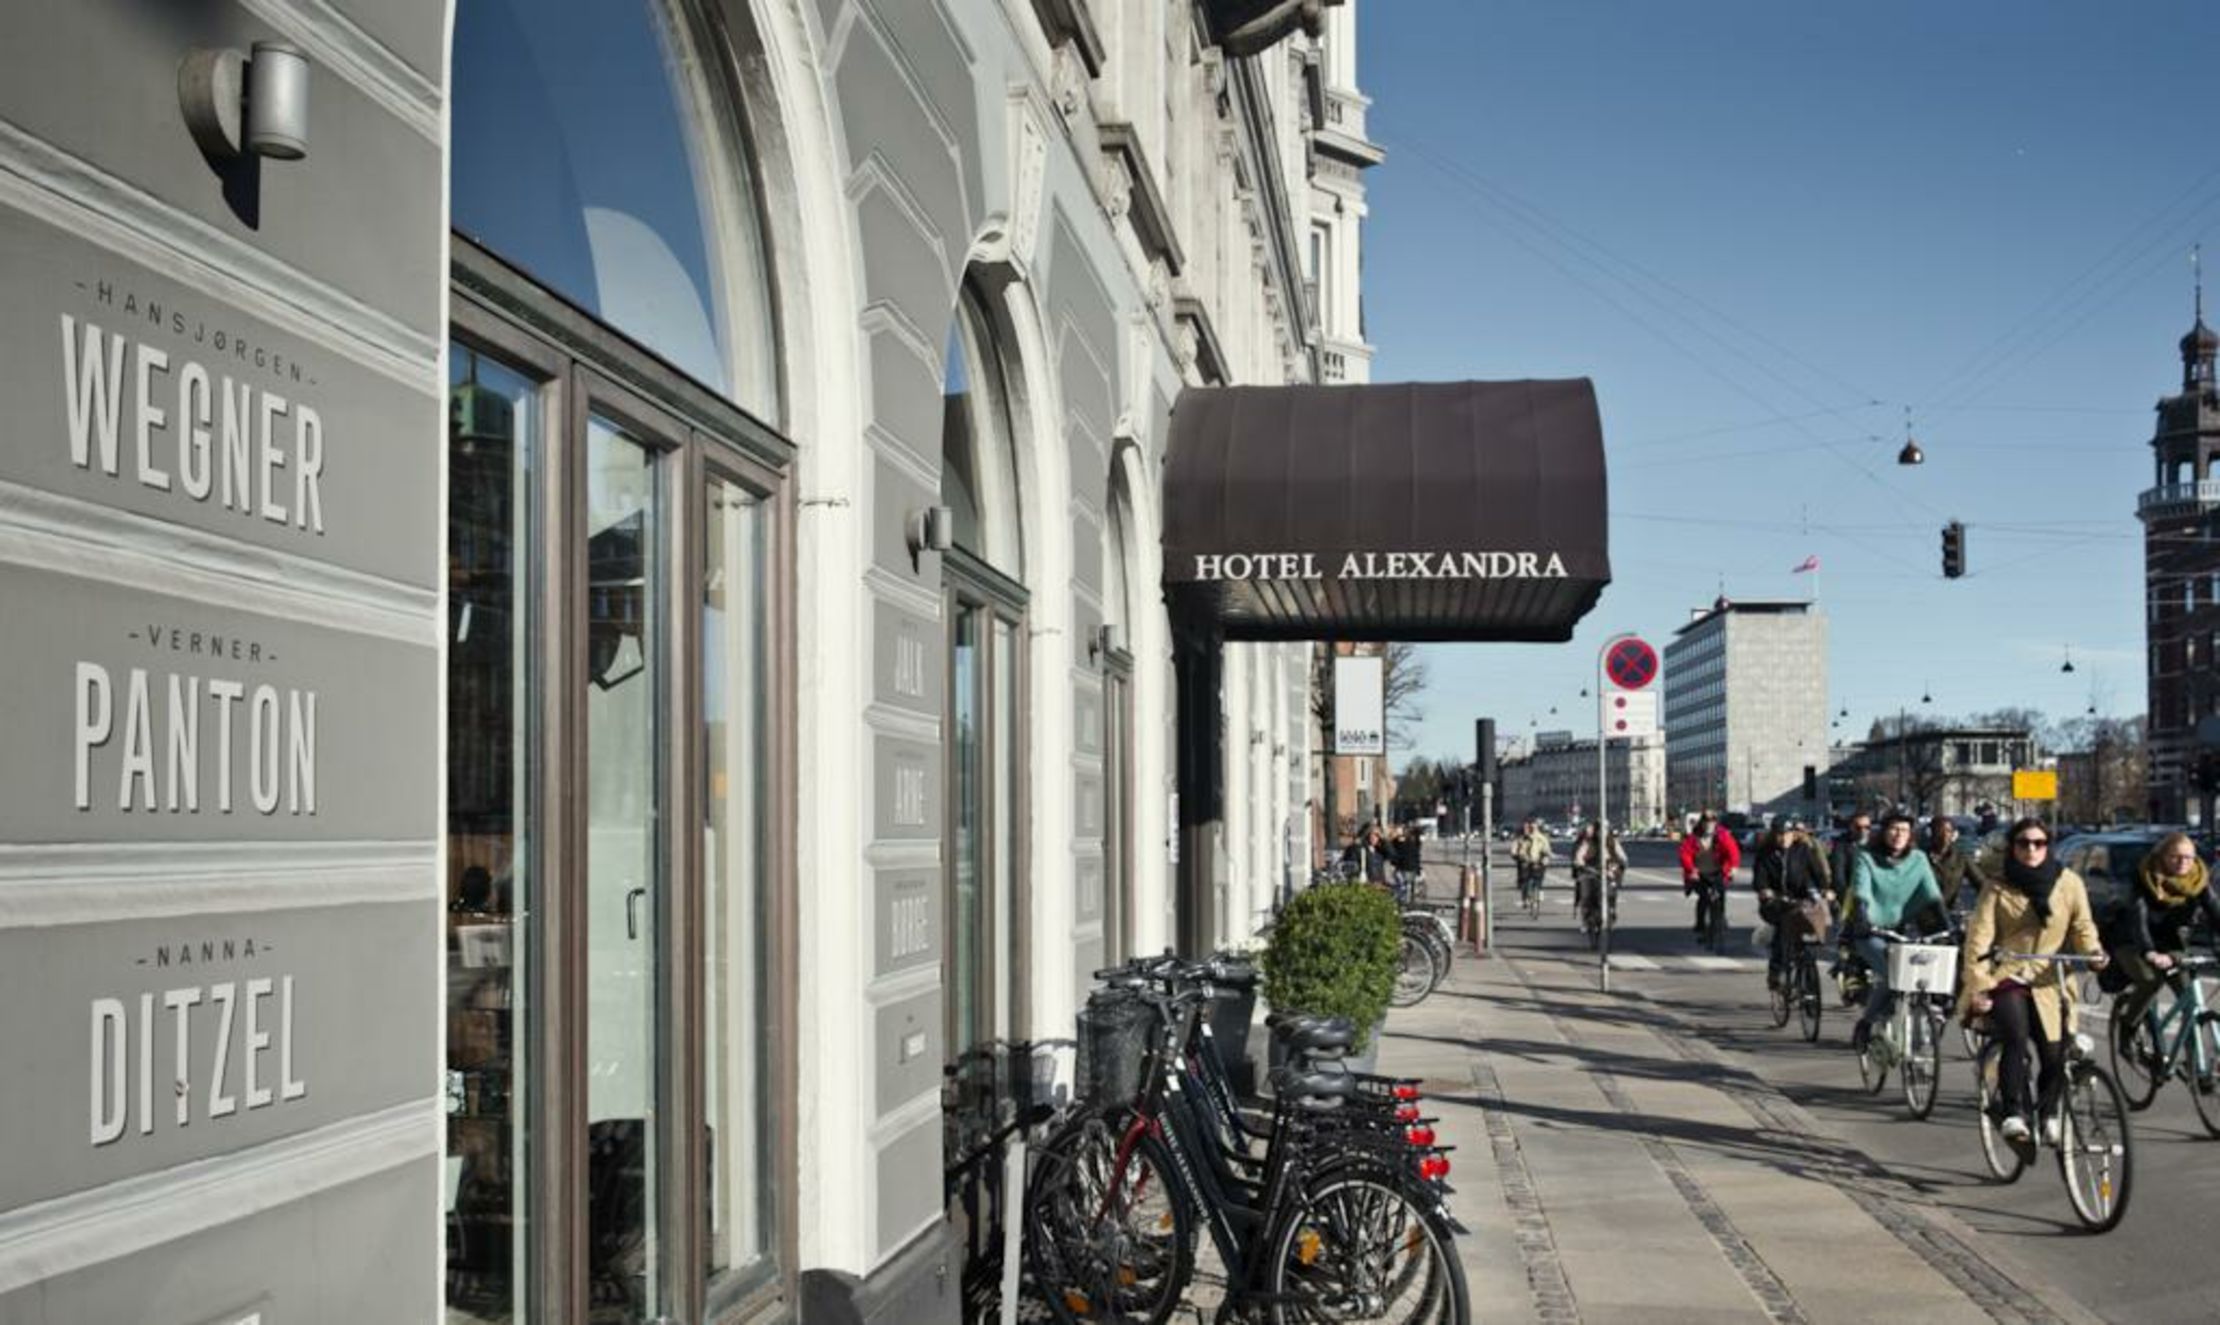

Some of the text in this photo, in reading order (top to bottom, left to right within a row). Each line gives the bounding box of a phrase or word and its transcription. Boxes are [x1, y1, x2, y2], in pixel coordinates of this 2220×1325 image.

[61, 313, 324, 535] WEGNER
[1194, 551, 1568, 581] HOTEL ALEXANDRA
[75, 661, 317, 815] PANTON
[91, 974, 306, 1147] DITZEL
